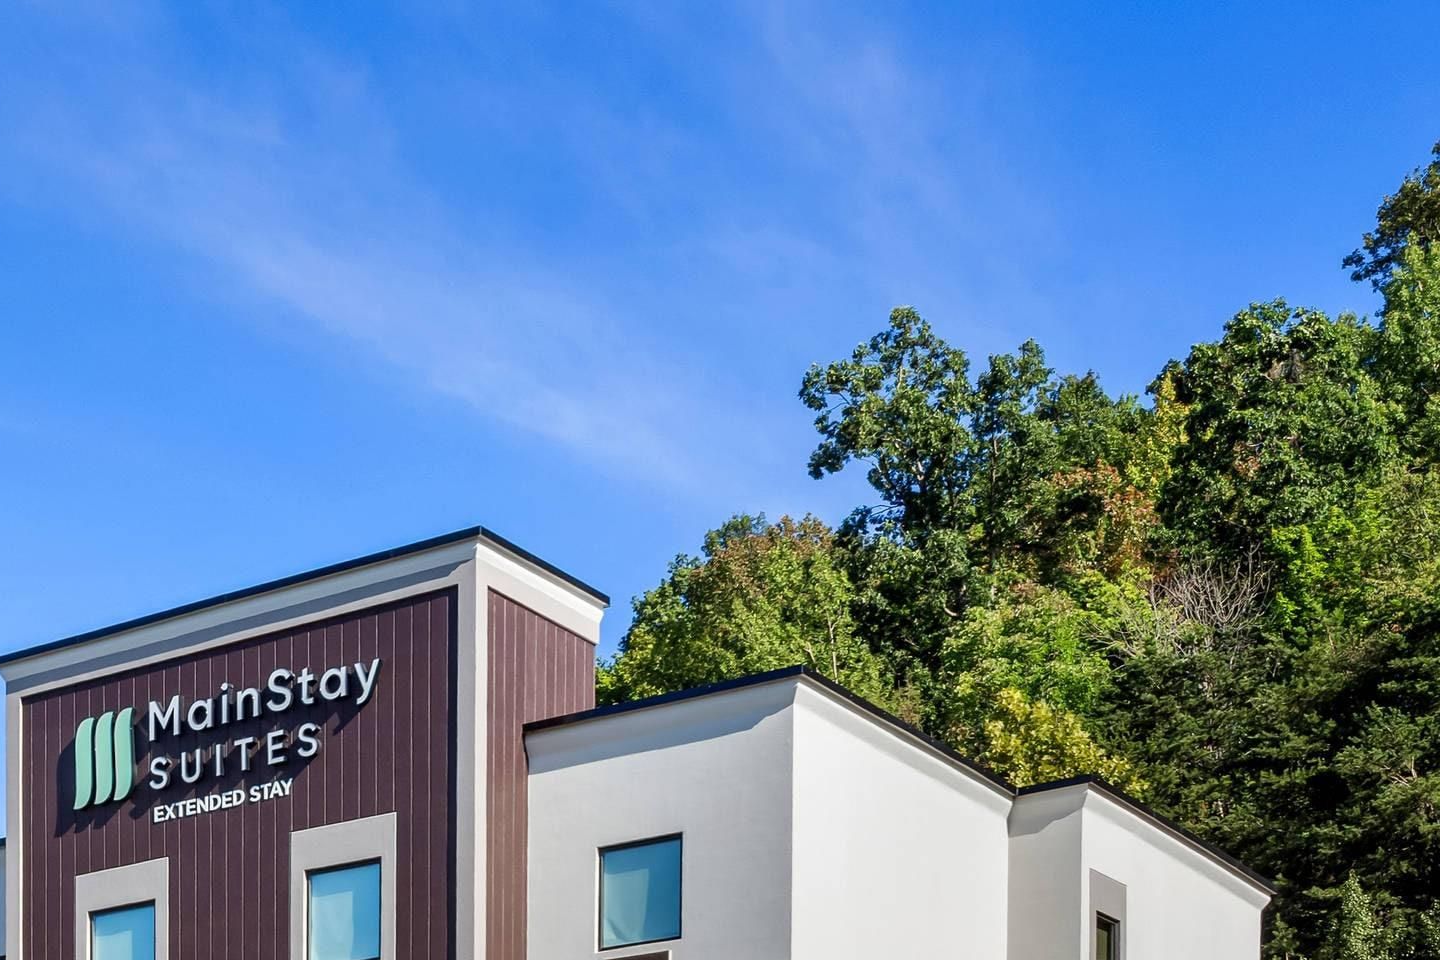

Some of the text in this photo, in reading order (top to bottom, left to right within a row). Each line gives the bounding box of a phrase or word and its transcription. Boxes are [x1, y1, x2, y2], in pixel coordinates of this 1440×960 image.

[148, 658, 382, 742] MainStay
[148, 722, 322, 790] SUITES
[153, 778, 294, 824] EXTENDED STAY
